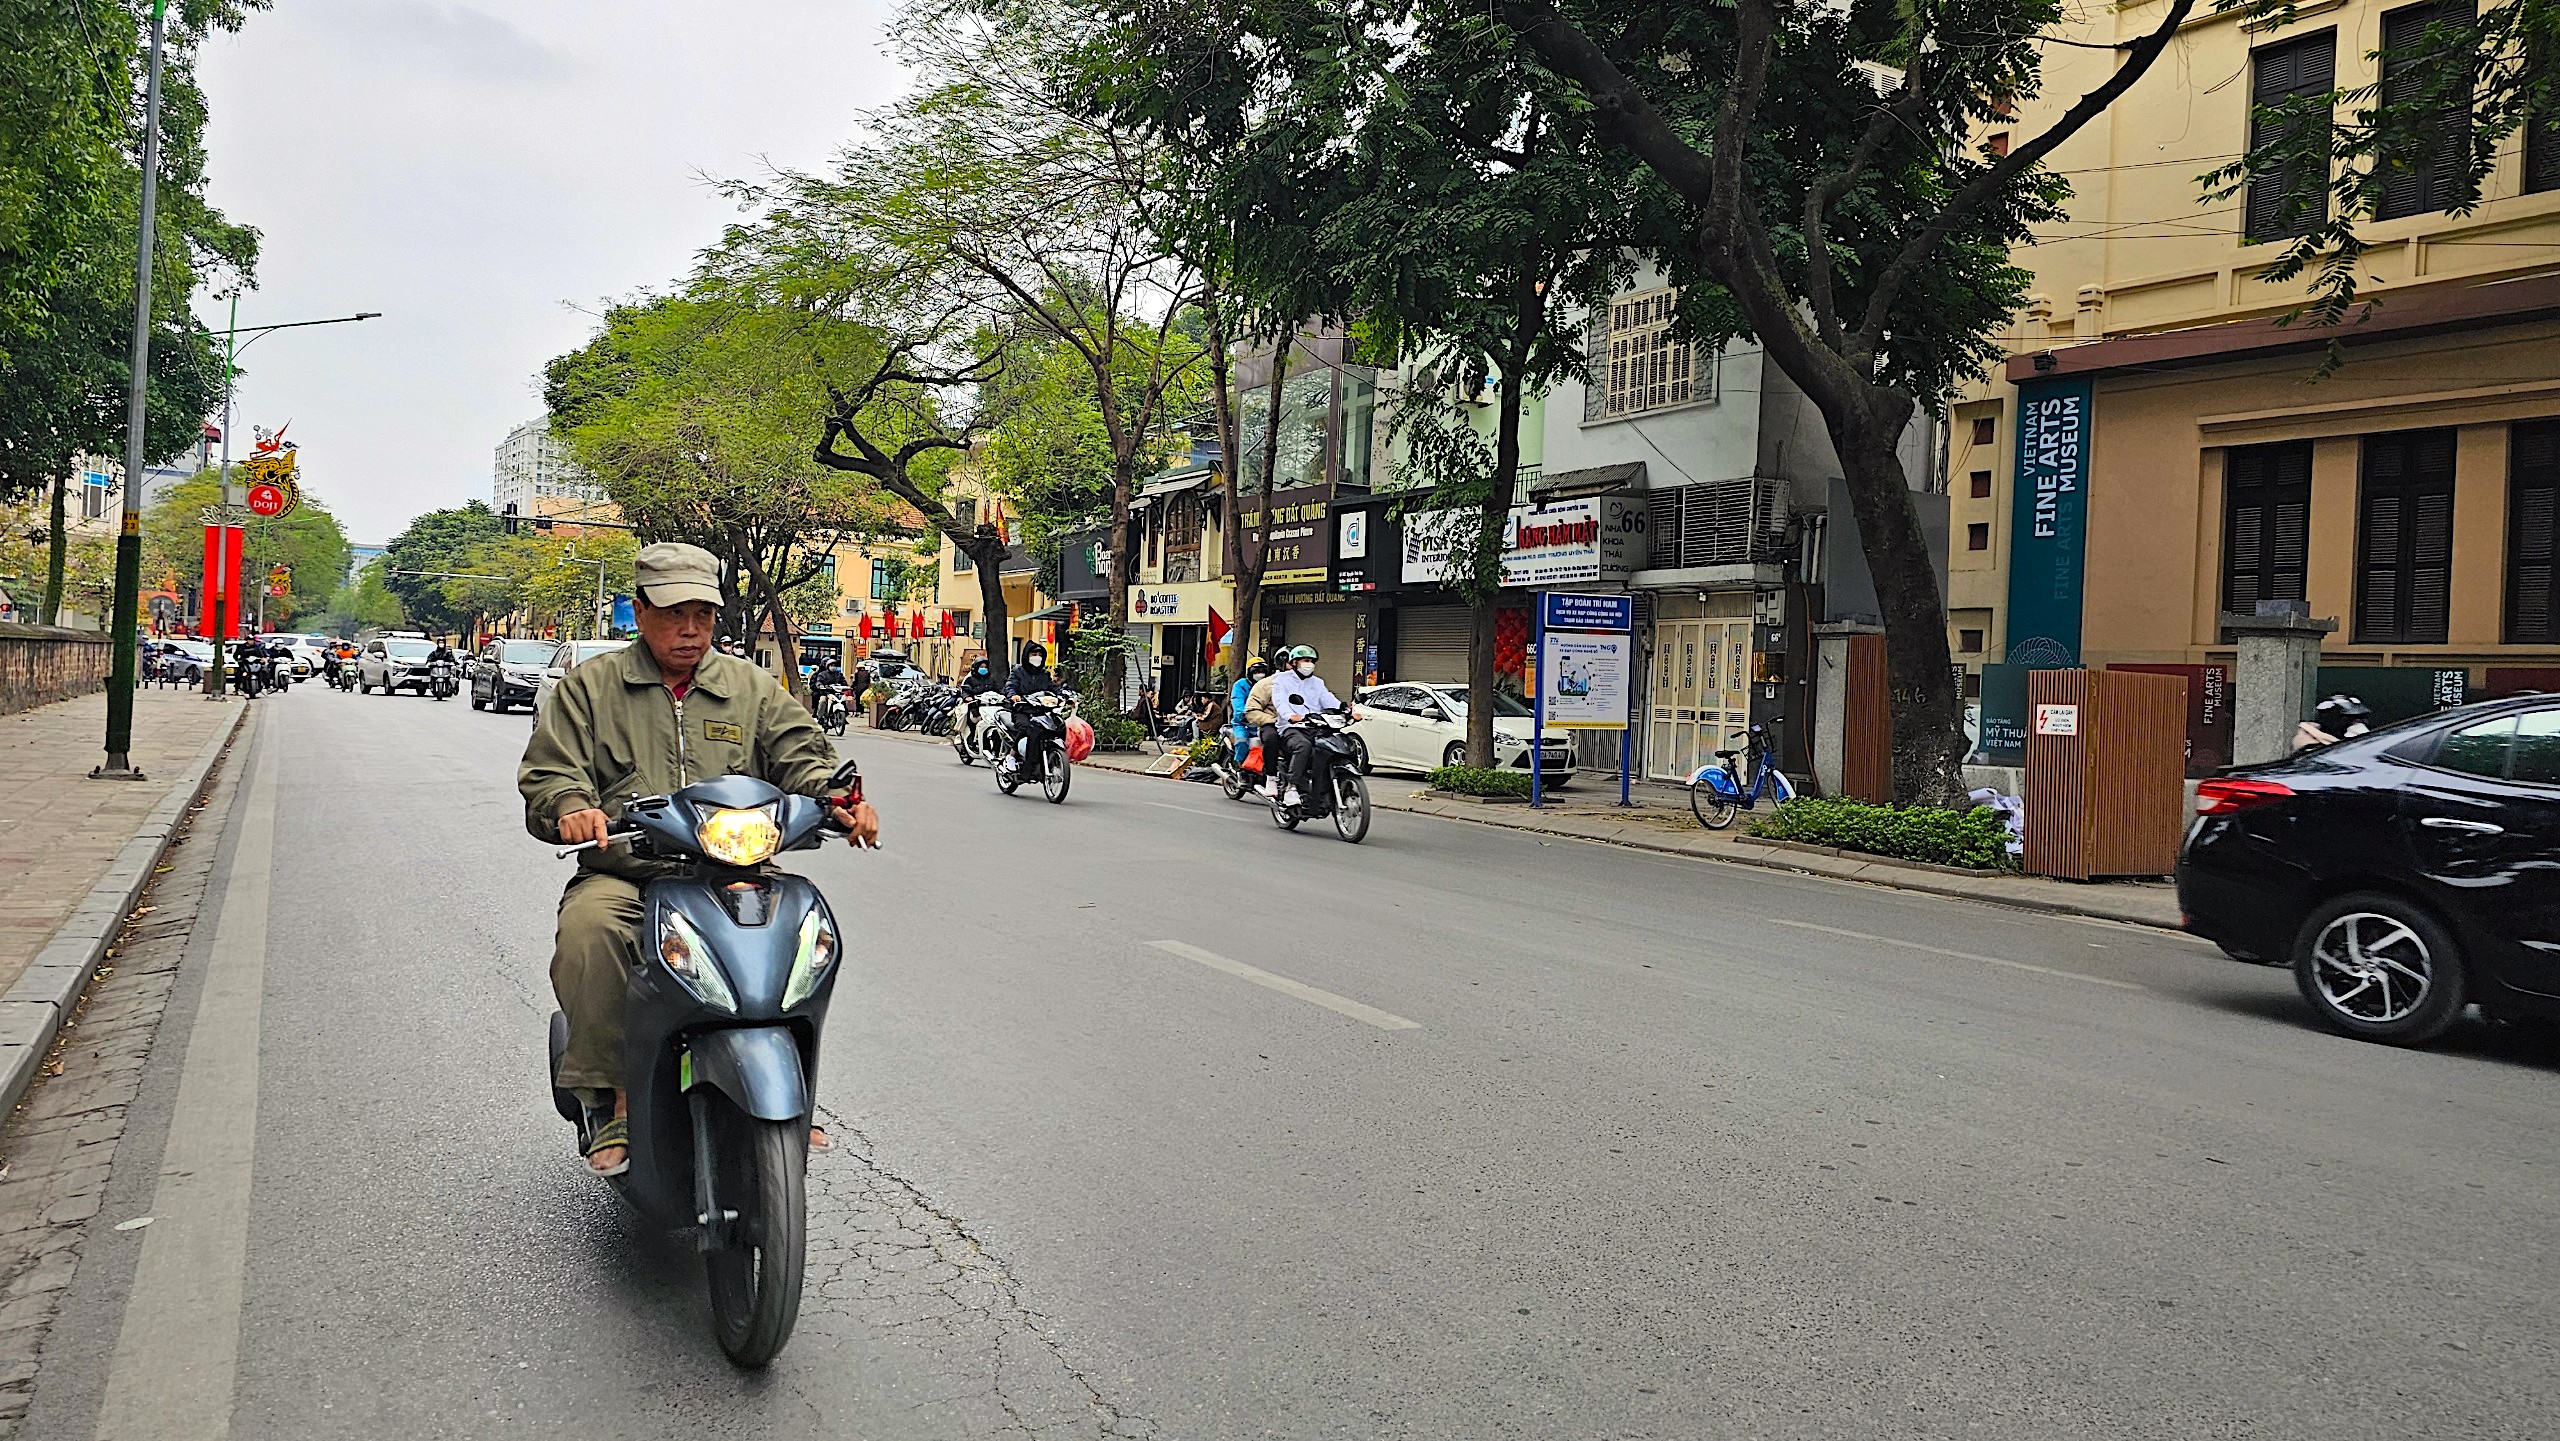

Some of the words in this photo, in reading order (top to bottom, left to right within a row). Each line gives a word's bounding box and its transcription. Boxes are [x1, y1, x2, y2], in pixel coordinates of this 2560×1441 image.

[2023, 402, 2038, 477] VIETNAM
[2038, 398, 2061, 468] ARTS
[2059, 396, 2080, 492] MUSEUM
[253, 500, 278, 511] DOJI
[2034, 475, 2058, 537] FINE
[1622, 511, 1645, 533] 66
[1422, 553, 1449, 562] INTERIO
[1604, 549, 1622, 558] THÁI
[1956, 666, 1964, 700] MUSEUM
[2205, 668, 2215, 697] ARTS
[2214, 668, 2222, 707] MUSEUM
[2442, 671, 2453, 703] ARTS
[2453, 671, 2463, 708] USEUM
[2204, 698, 2213, 724] FINE
[1986, 725, 2000, 737] MỸ
[2002, 727, 2027, 739] THU
[1986, 738, 2003, 748] VIỆT
[2004, 740, 2021, 748] NAM
